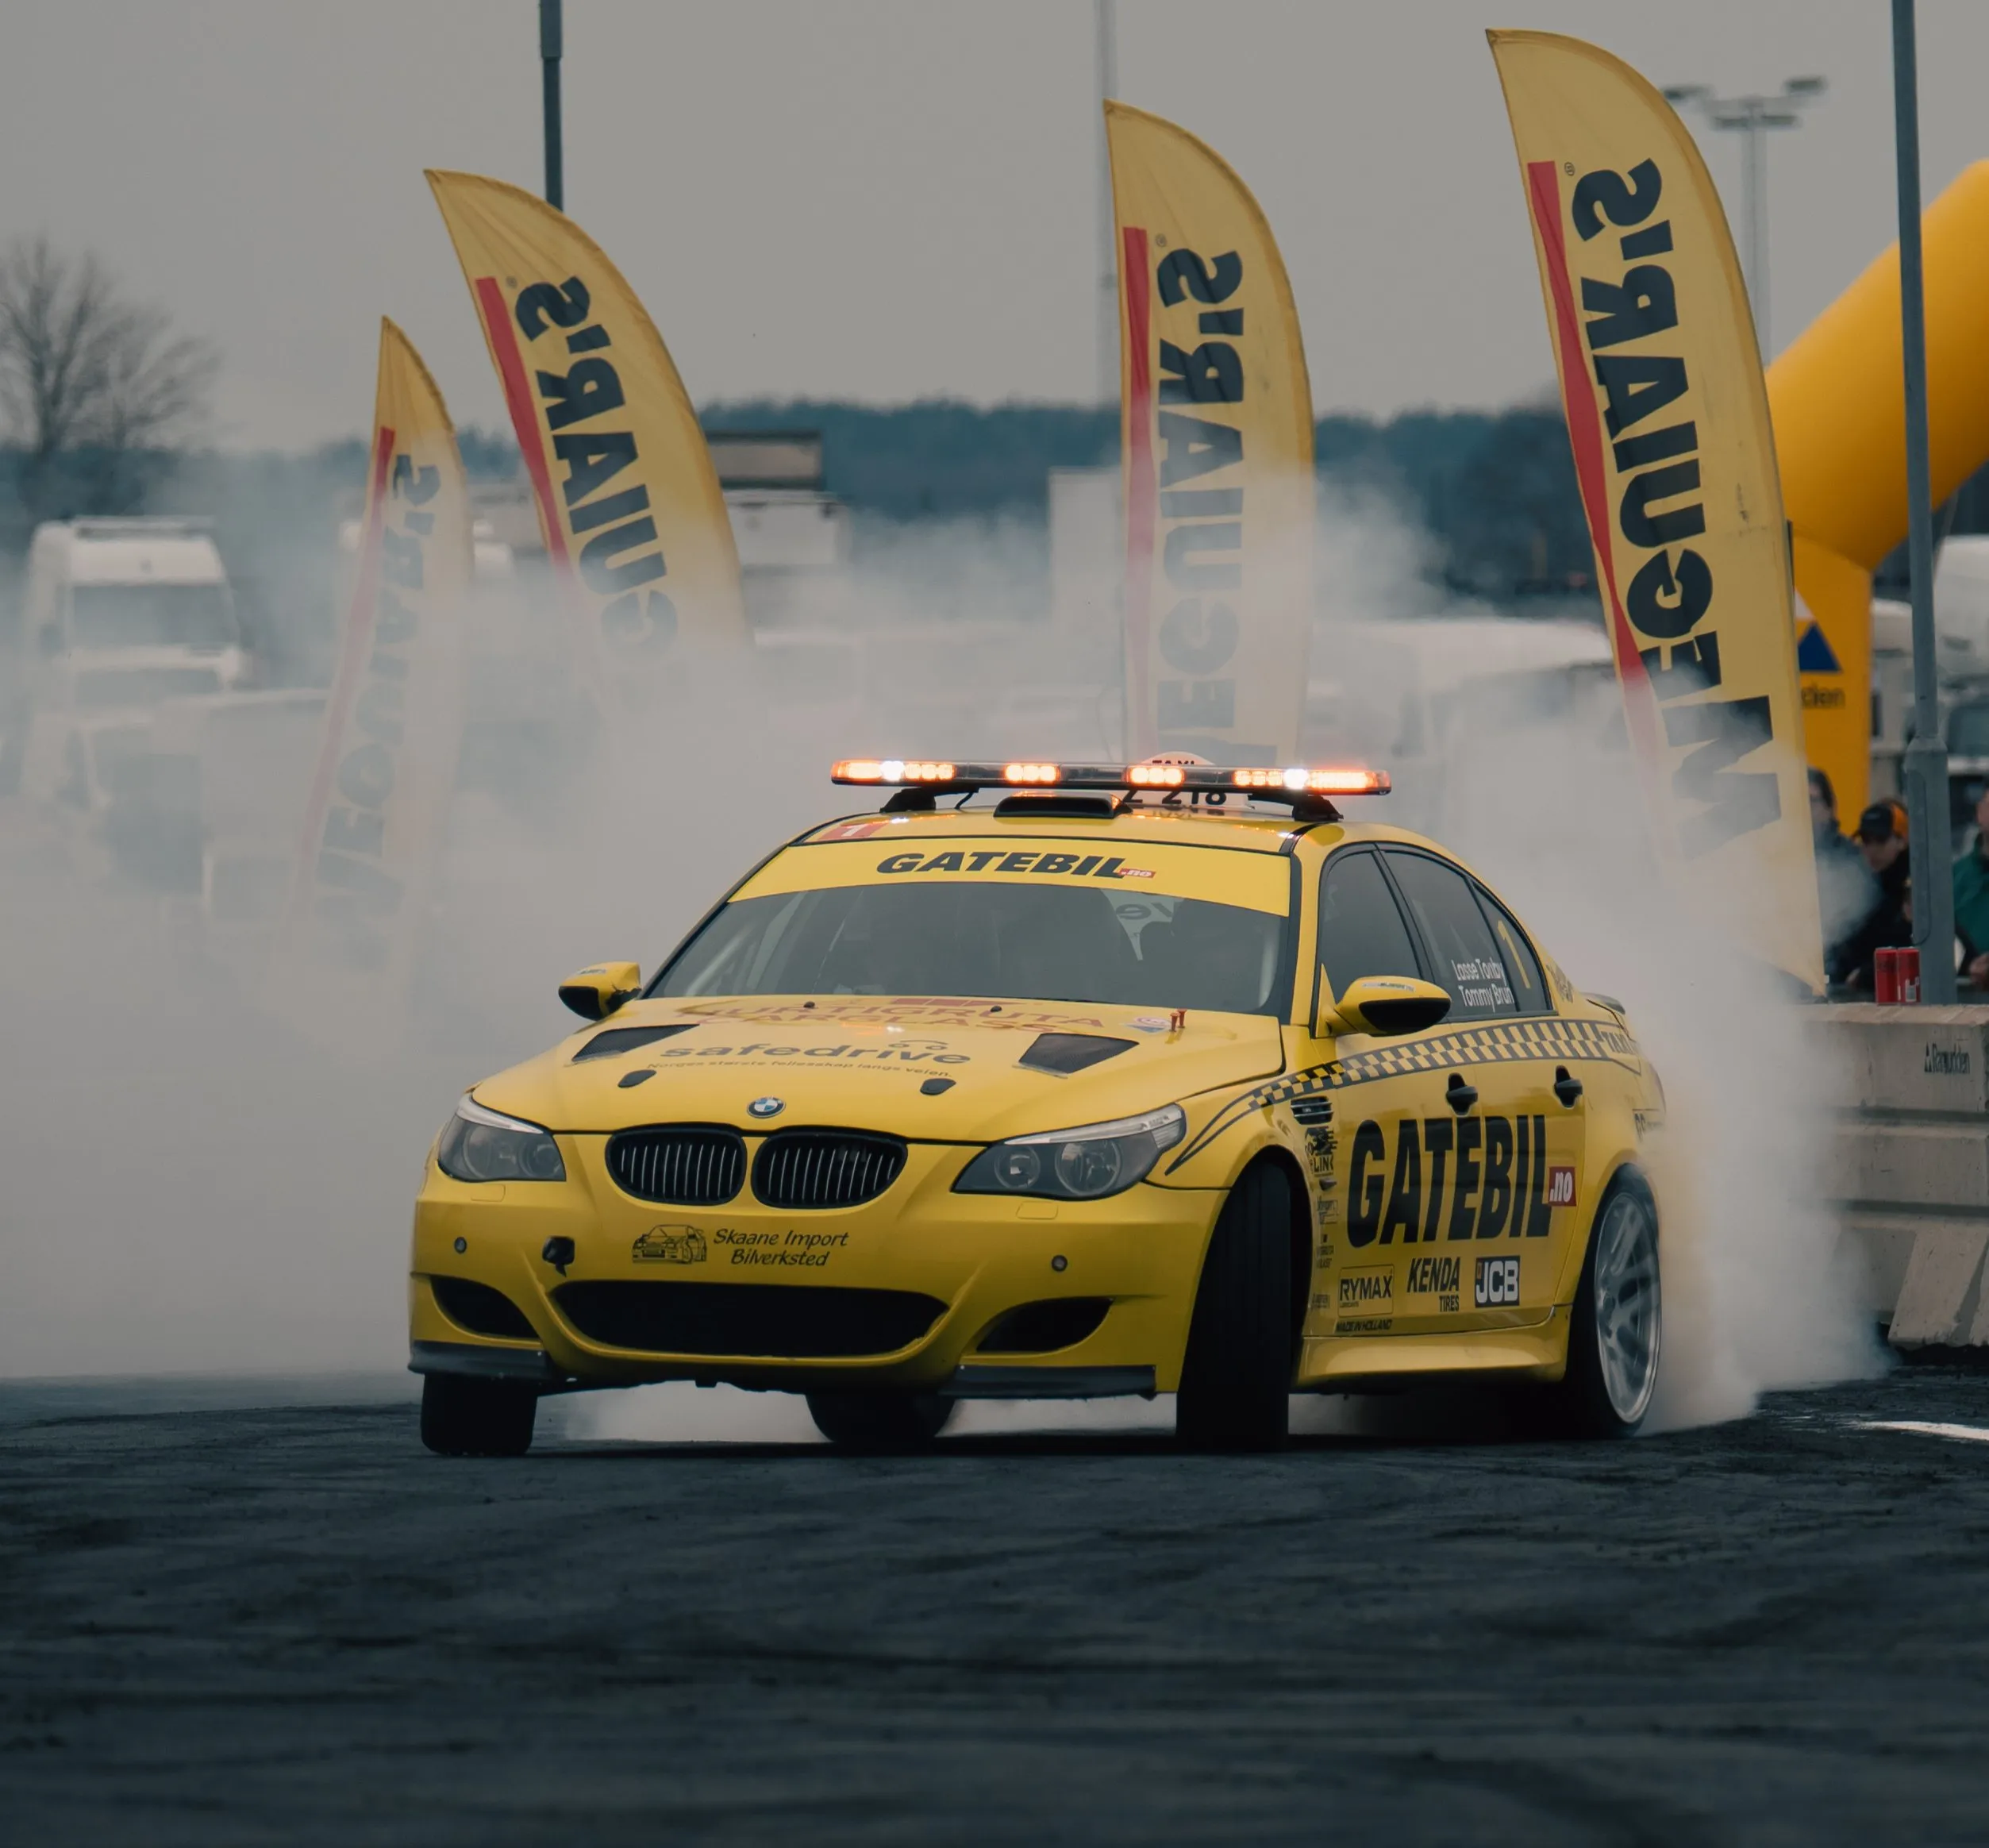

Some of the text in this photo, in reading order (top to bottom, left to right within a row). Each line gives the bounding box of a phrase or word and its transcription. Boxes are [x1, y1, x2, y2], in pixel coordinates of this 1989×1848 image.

[876, 852, 1126, 879] GATEBIL
[1457, 984, 1495, 1013] Tommy
[660, 1042, 971, 1064] safedrive
[1347, 1115, 1552, 1249] GATEBIL
[714, 1228, 849, 1250] Skaane Import
[730, 1248, 830, 1267] Bilverksted
[1406, 1256, 1461, 1293] KENDA
[1475, 1260, 1519, 1304] JCB
[1339, 1275, 1393, 1301] RYMAX
[1439, 1296, 1460, 1312] TIRES
